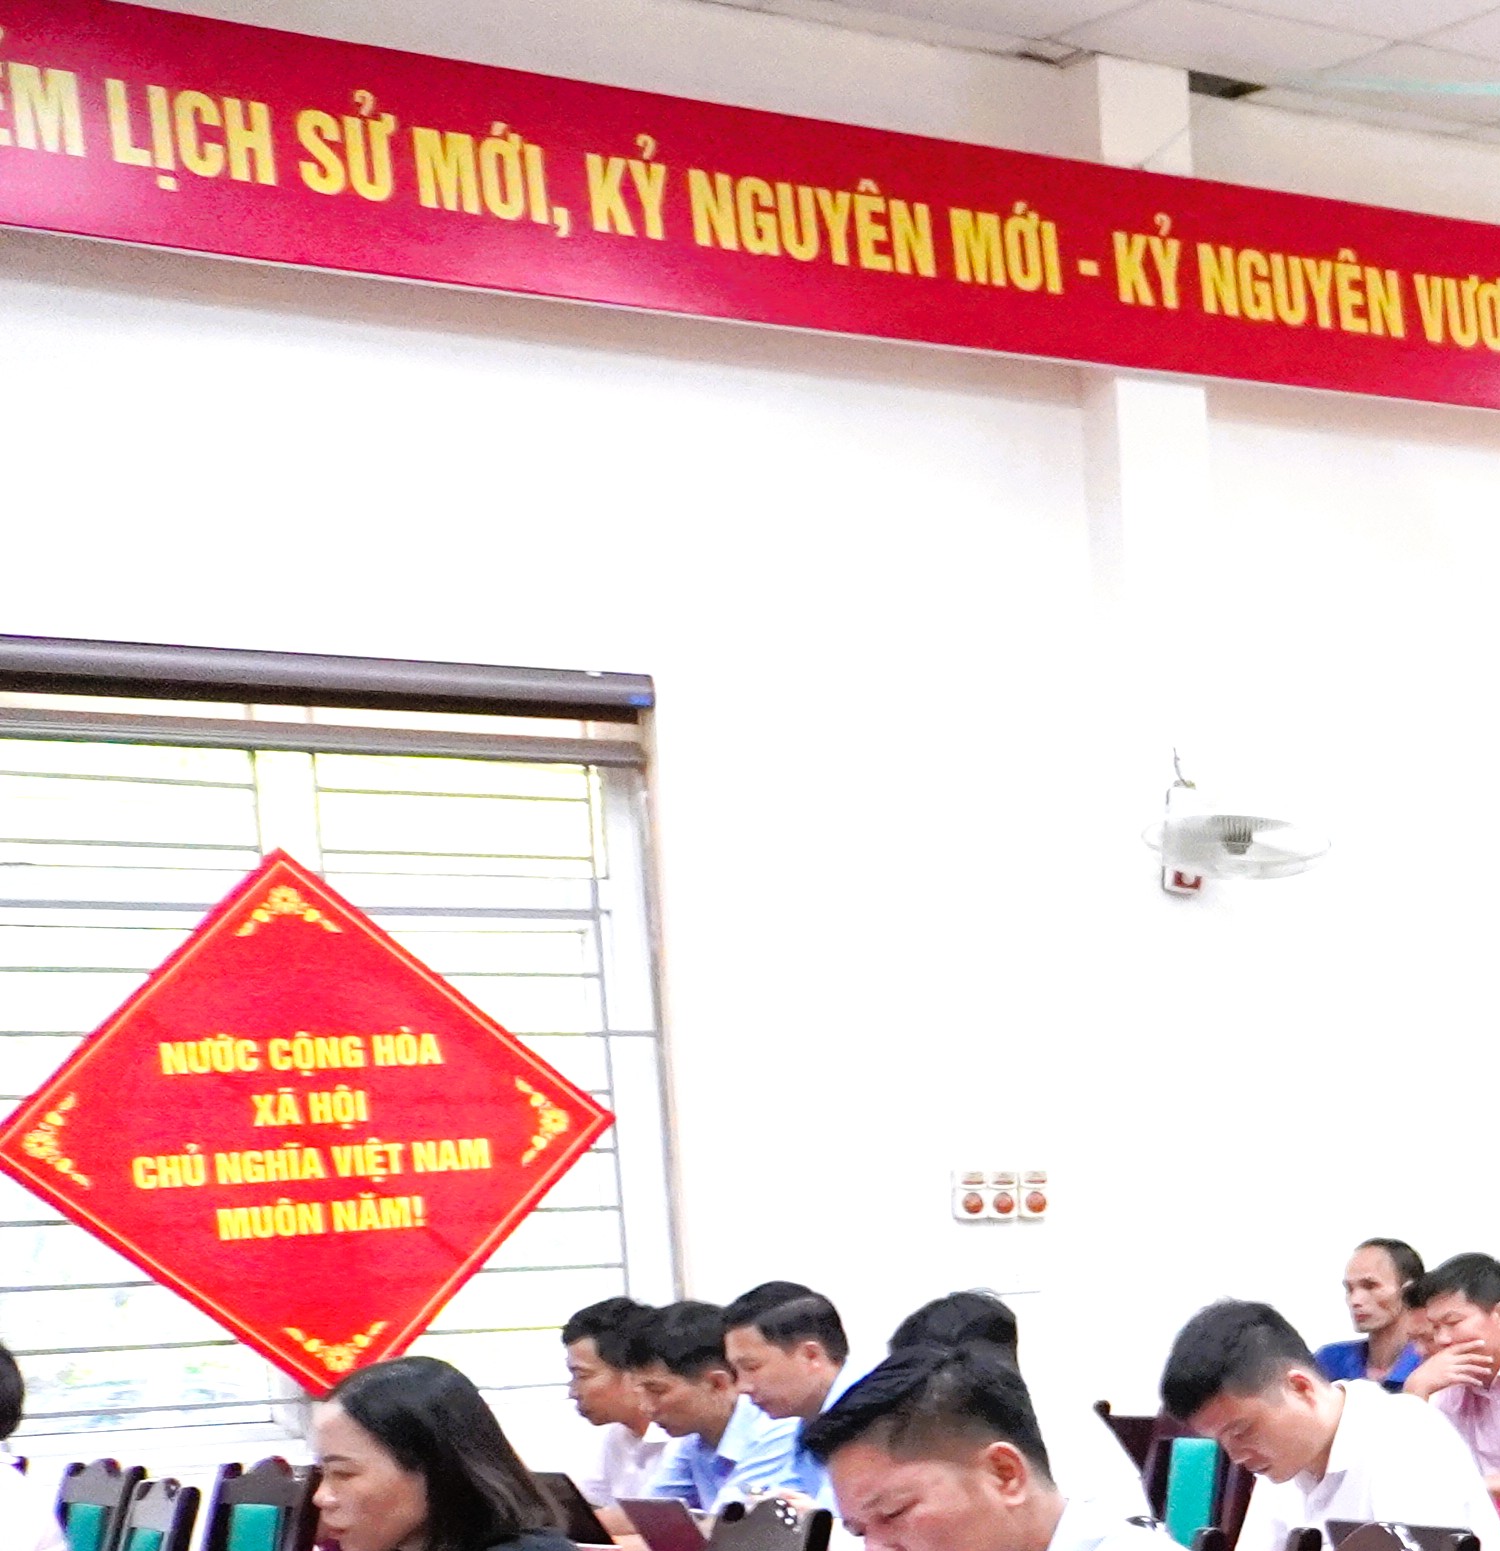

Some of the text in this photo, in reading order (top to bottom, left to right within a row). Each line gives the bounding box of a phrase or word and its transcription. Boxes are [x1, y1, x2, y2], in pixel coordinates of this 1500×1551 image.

[0, 27, 86, 157] M
[106, 78, 279, 192] LỊCH
[296, 90, 396, 201] SỬ
[412, 122, 570, 237] MỚI,
[586, 135, 667, 240] KỶ
[688, 169, 937, 278] NGUYÊN
[949, 201, 1063, 295] MỚI
[1077, 259, 1100, 277] -
[1113, 213, 1181, 309] KỶ
[1197, 243, 1406, 339] NGUYÊN
[158, 1025, 445, 1077] NƯỚC CỘNG HÒA
[252, 1083, 371, 1130] XÃ HỘI
[132, 1137, 494, 1190] CHỦ NGHĨA VIỆT NAM
[216, 1191, 427, 1241] MUÔN NĂM!
